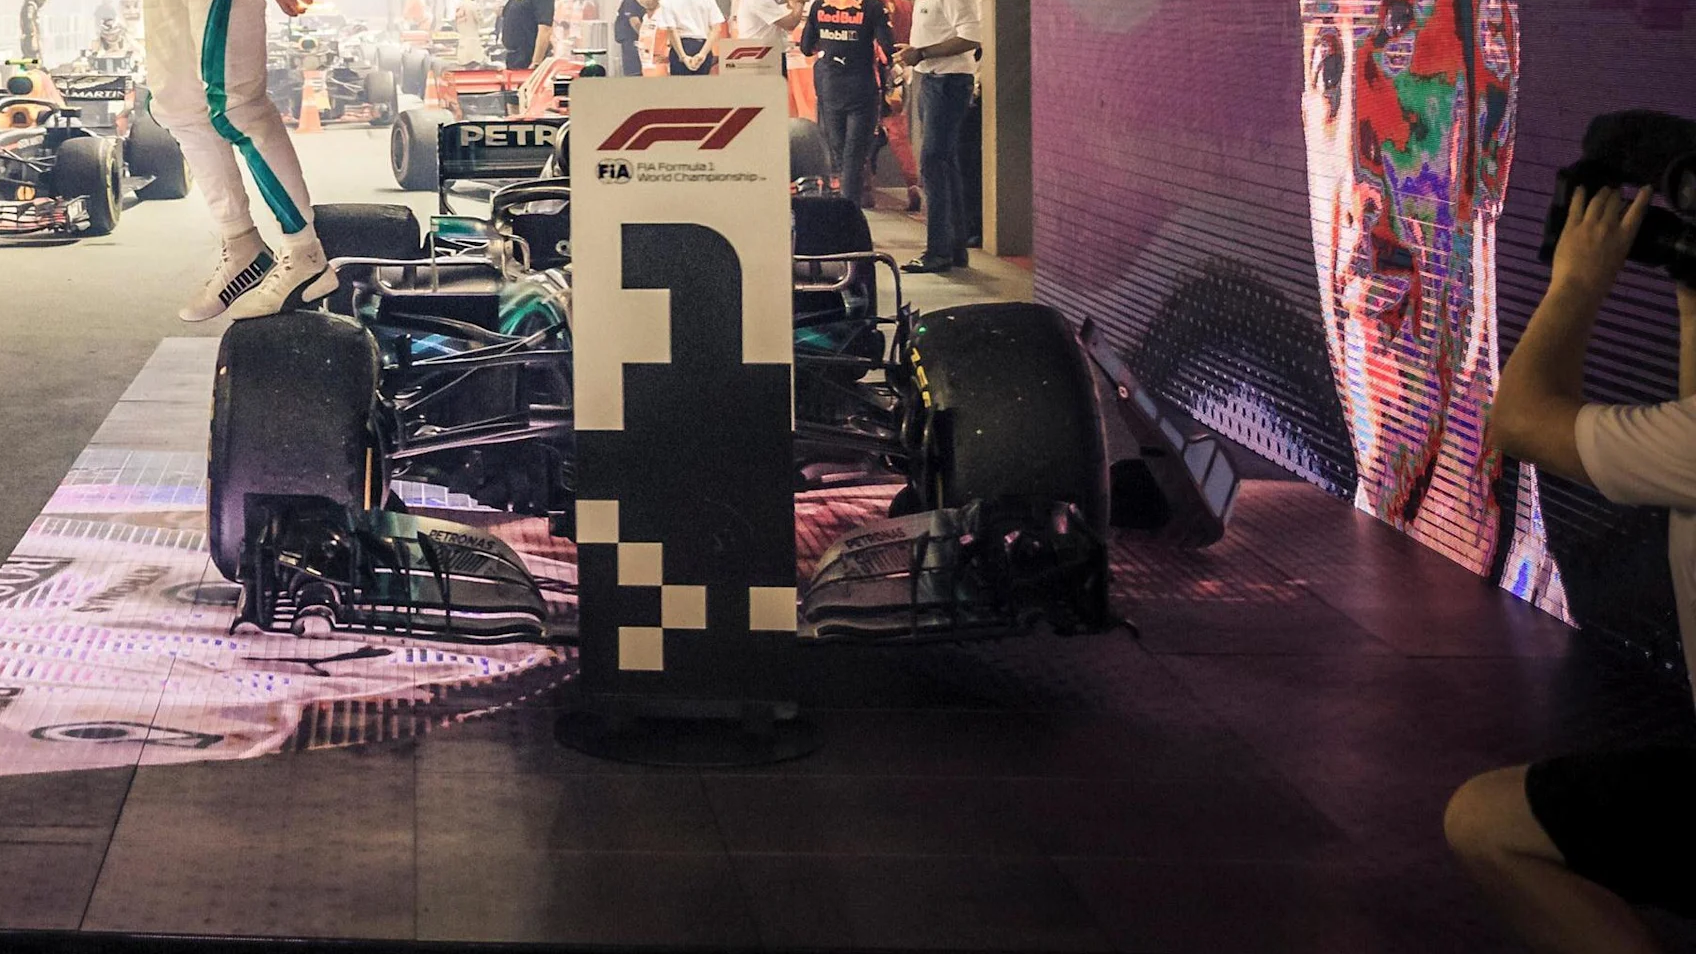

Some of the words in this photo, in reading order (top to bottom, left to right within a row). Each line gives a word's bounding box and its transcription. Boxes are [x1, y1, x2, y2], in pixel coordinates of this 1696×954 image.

[819, 29, 848, 41] Mobil
[596, 107, 765, 151] F1
[598, 163, 632, 180] FIA
[637, 162, 655, 172] FIA
[658, 162, 706, 172] Formula
[708, 162, 716, 172] 1
[637, 173, 672, 182] World
[674, 173, 758, 184] Championship
[429, 529, 496, 550] PETRONAS
